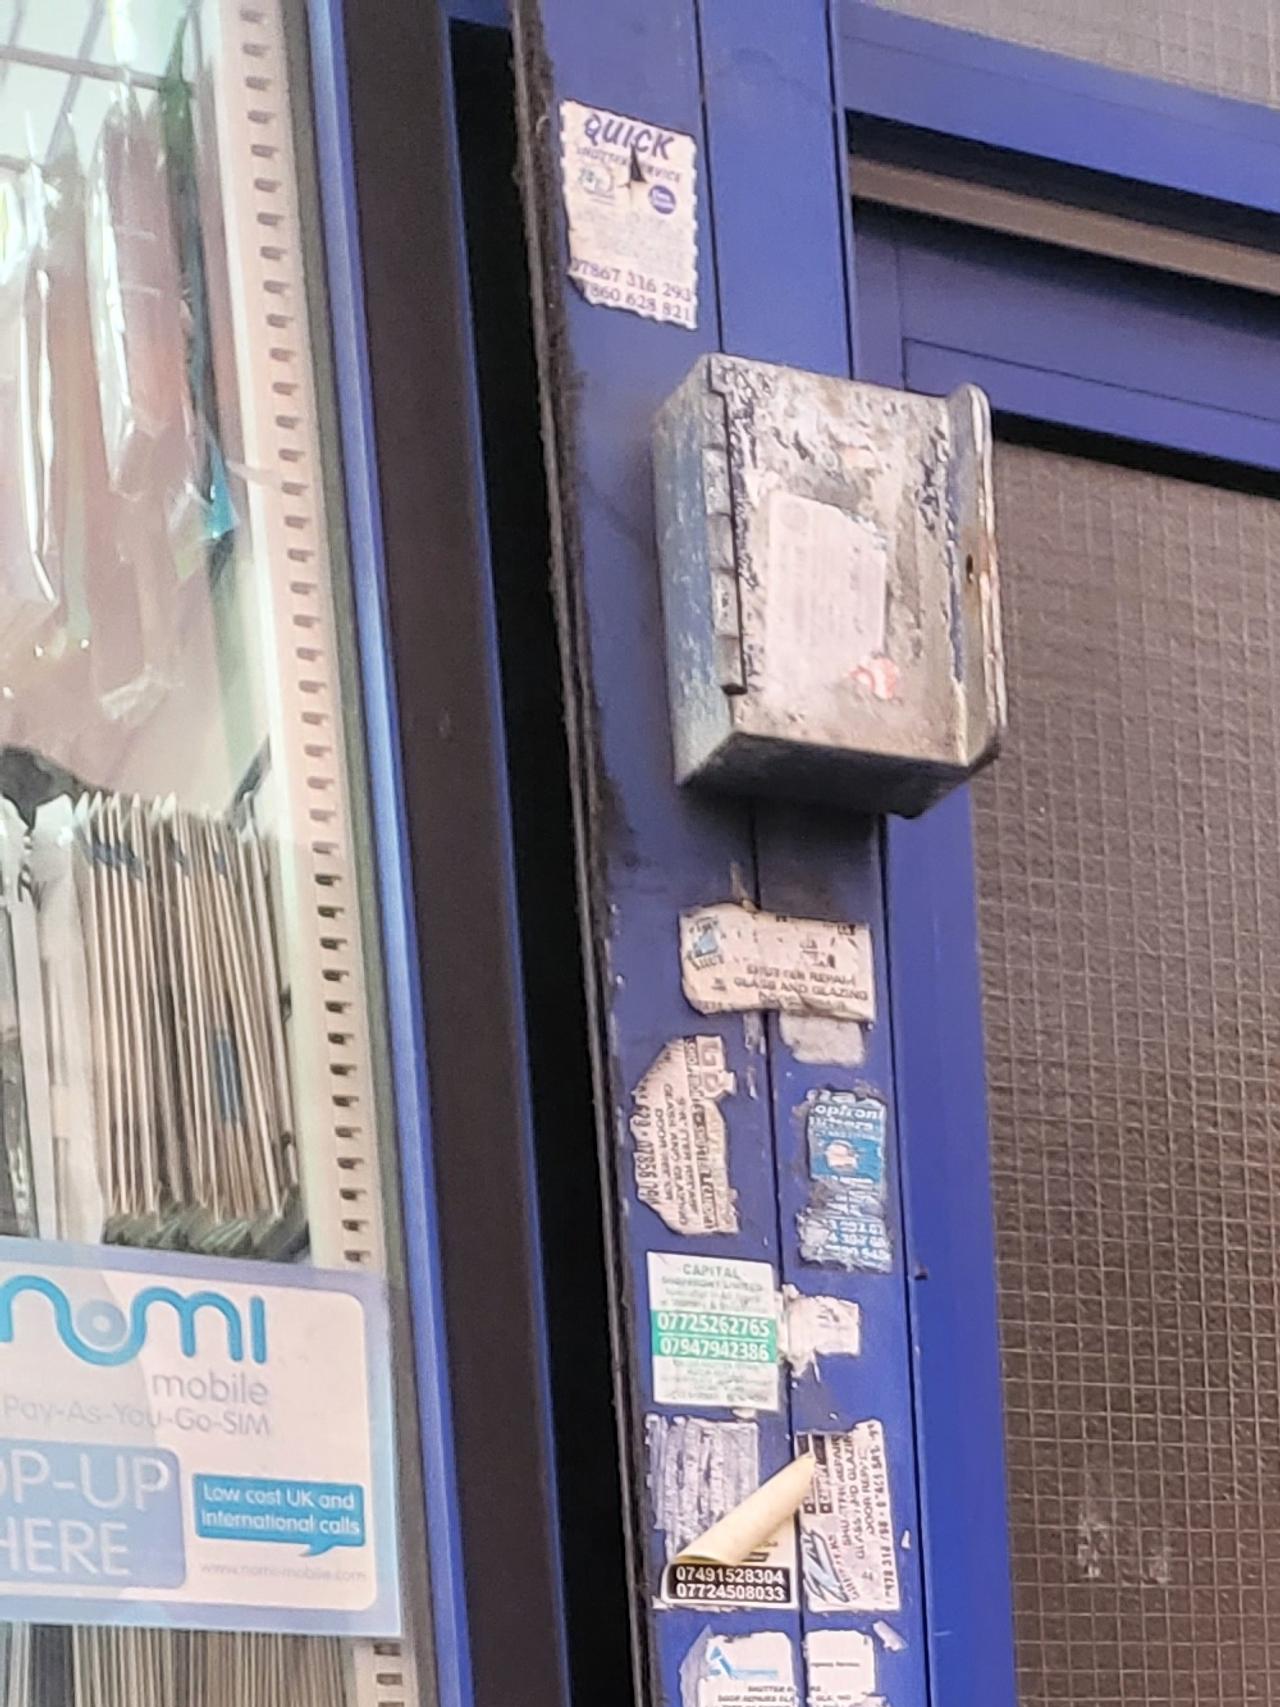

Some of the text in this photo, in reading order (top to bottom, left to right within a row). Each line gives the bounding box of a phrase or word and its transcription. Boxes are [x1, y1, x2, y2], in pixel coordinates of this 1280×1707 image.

[584, 113, 675, 160] QUICK
[682, 1263, 741, 1280] CAPITAL
[656, 1312, 770, 1338] 07725262765
[660, 1336, 770, 1361] 07947942386
[152, 1370, 269, 1407] mobile
[0, 1449, 170, 1512] P-UP
[203, 1482, 355, 1511] Low cost UK and
[318, 1515, 361, 1536] calls
[675, 1566, 784, 1585] 07491528304
[675, 1583, 785, 1601] 07724508033
